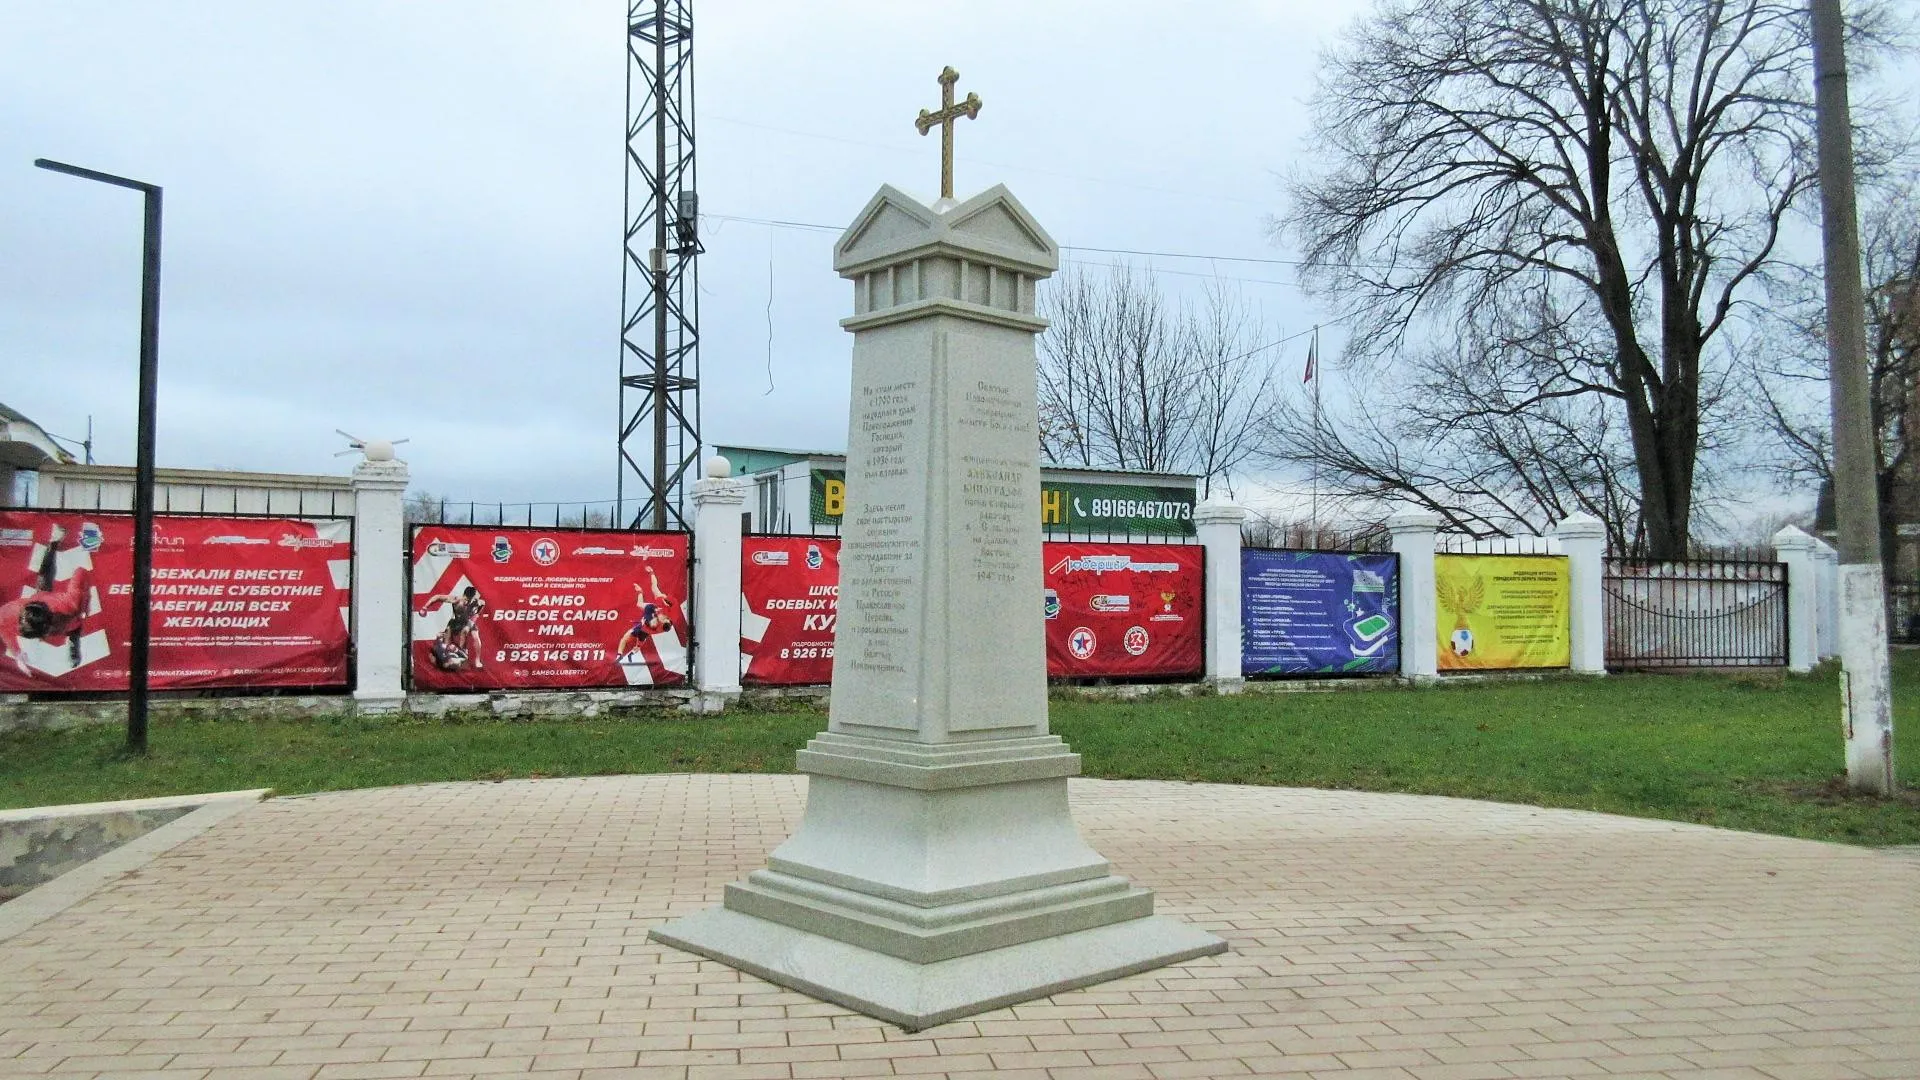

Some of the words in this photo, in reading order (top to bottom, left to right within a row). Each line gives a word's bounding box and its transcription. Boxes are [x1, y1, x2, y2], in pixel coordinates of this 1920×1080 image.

[1091, 498, 1191, 521] 89166467073
[132, 568, 230, 580] ОБЕЖАЛИ
[234, 568, 304, 581] ВМЕСТЕ!
[228, 585, 324, 596] СУББОТНИЕ
[808, 585, 839, 596] ШКО
[528, 595, 585, 606] САМБО
[766, 599, 827, 610] БОЕВЫХ
[209, 602, 243, 613] ДЛЯ
[250, 602, 292, 612] ВСЕХ
[493, 609, 560, 621] БОЕВОЕ
[562, 610, 619, 621] САМБО
[163, 617, 271, 629] ЖЕЛАЮЩИХ
[803, 614, 836, 633] КУ
[538, 624, 574, 636] ММА
[495, 650, 506, 661] 8
[510, 650, 539, 661] 926
[543, 650, 569, 661] 146
[573, 650, 588, 660] 81
[593, 649, 606, 660] 11
[780, 648, 789, 659] 8
[793, 648, 818, 659] 926
[820, 648, 835, 658] 19
